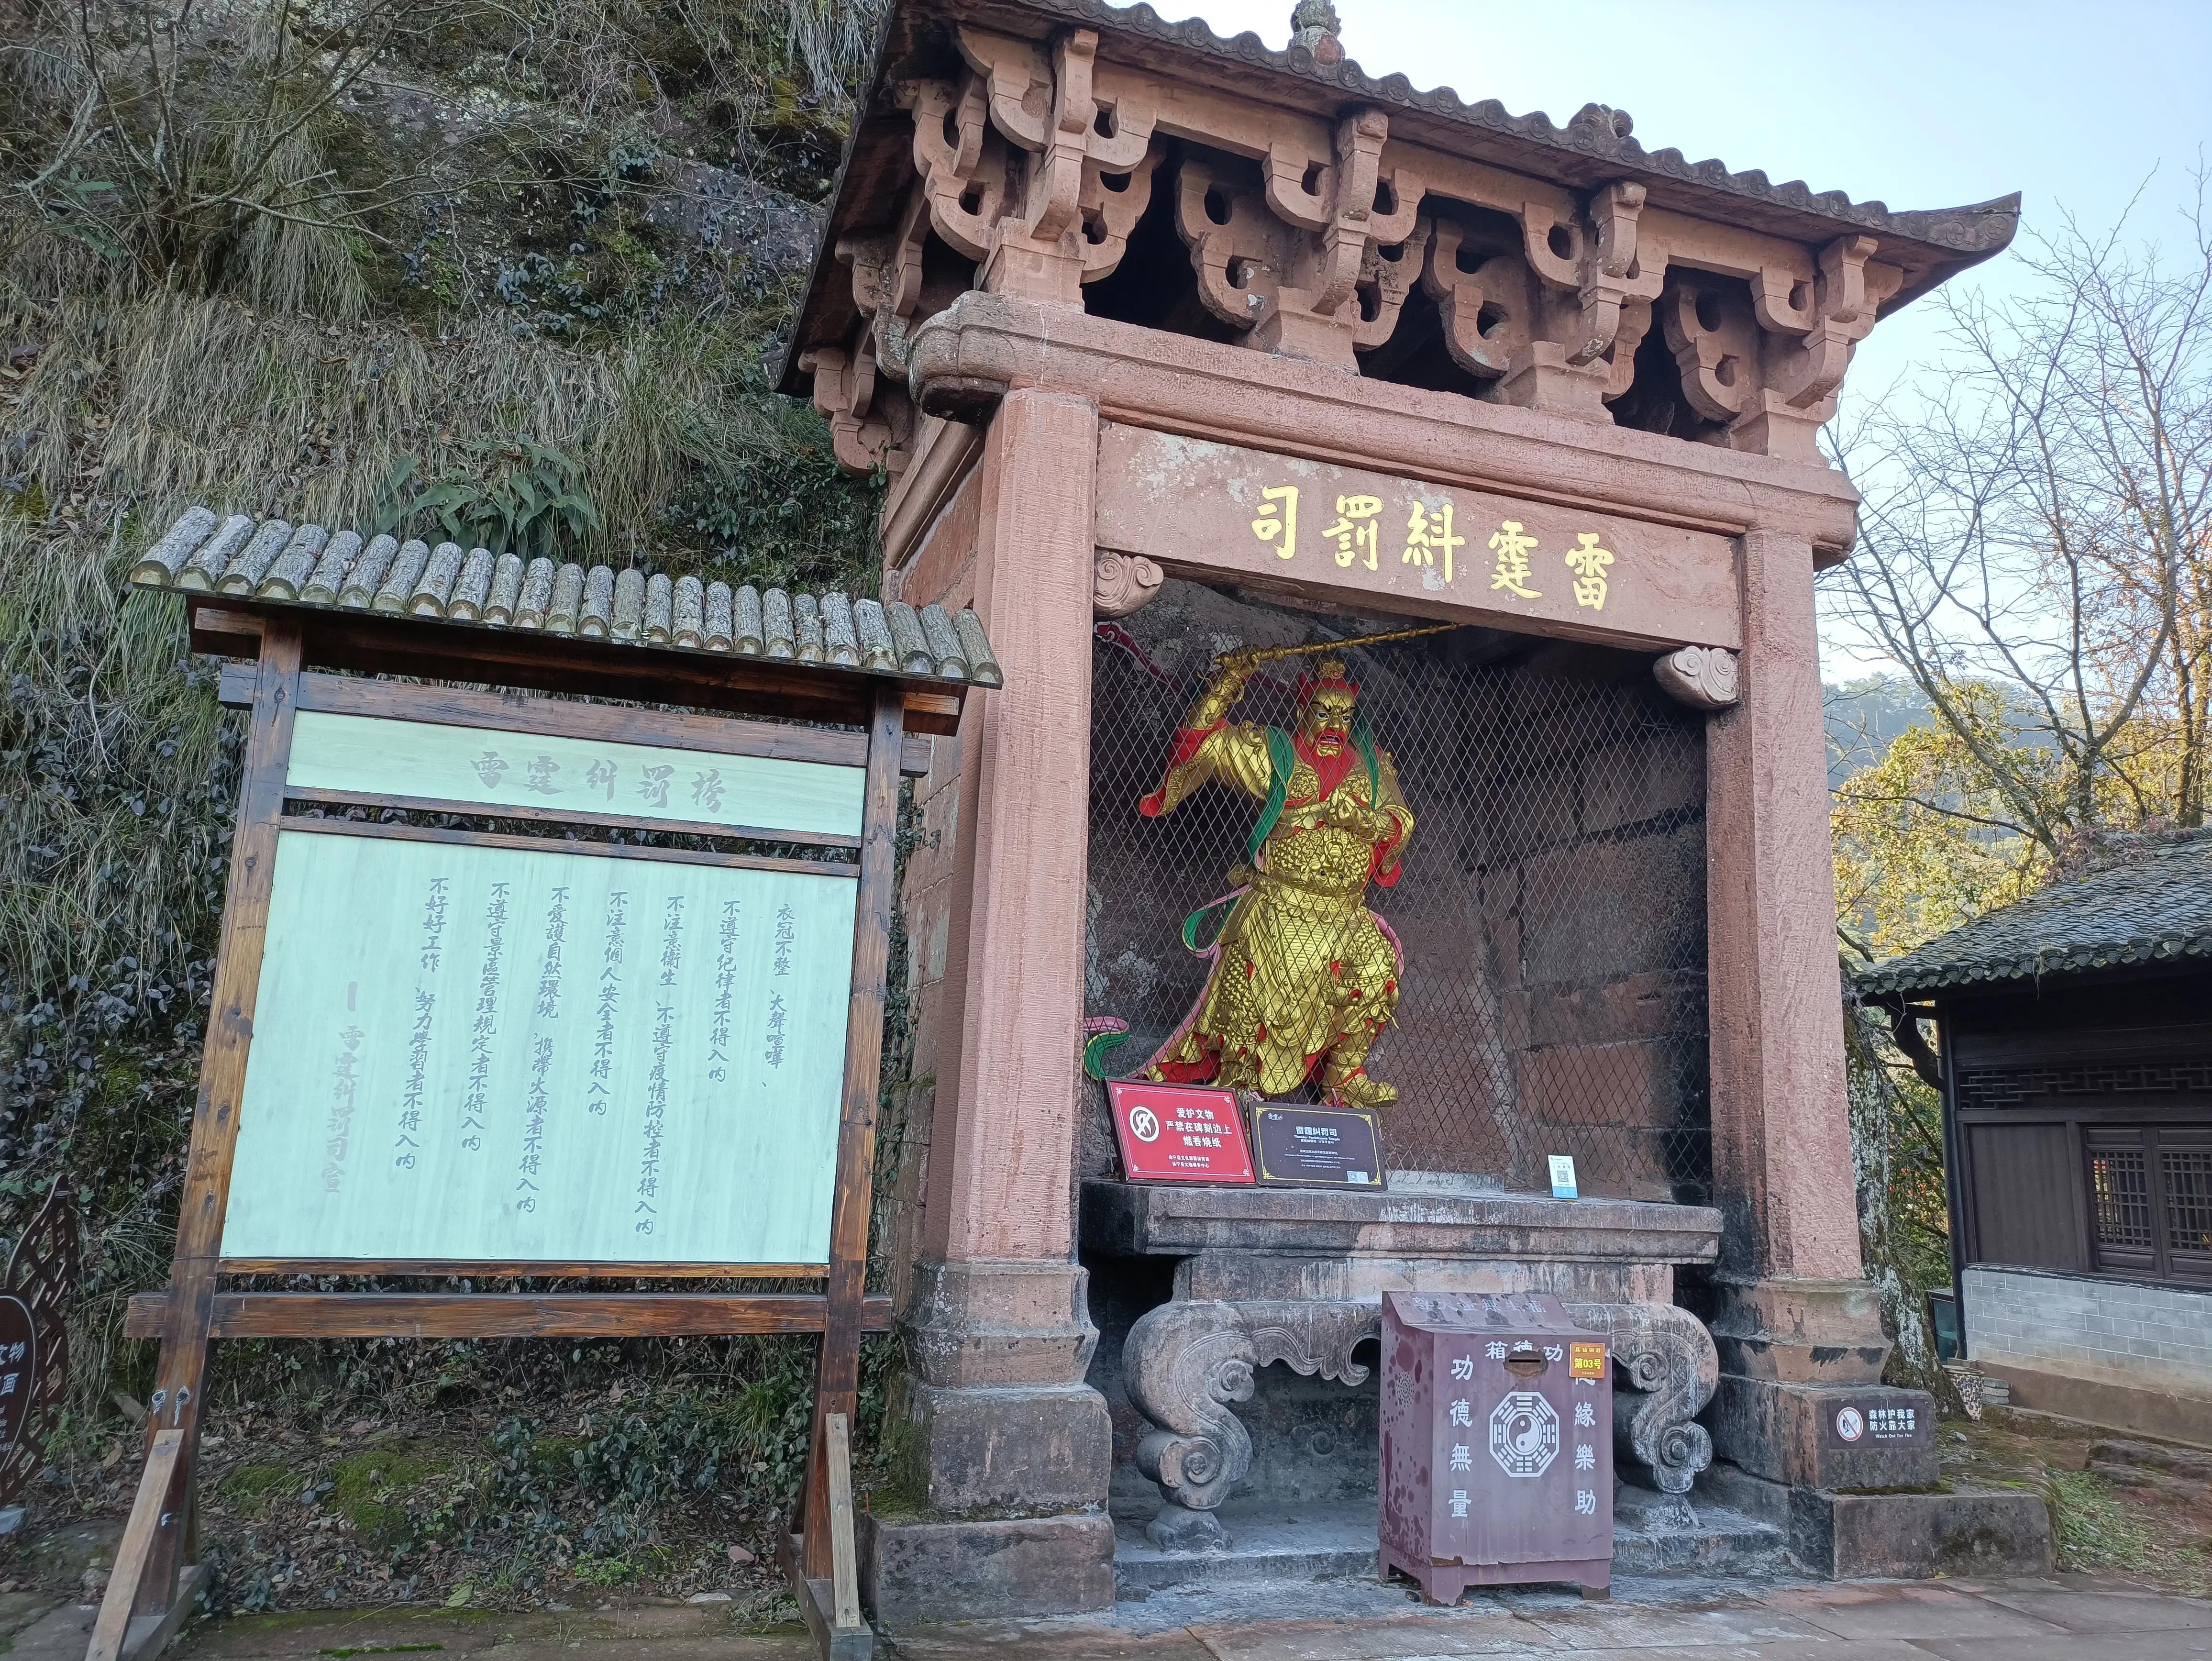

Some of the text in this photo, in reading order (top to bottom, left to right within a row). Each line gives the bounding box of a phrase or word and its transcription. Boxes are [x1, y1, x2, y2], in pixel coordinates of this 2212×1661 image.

[1176, 1107, 1214, 1120] 爱护文物
[1165, 1120, 1233, 1134] 严禁在碑刻边上
[1183, 1135, 1222, 1148] 燃香烧纸
[1574, 1358, 1601, 1369] 第03号
[1869, 1408, 1914, 1420] 森林护我家
[1869, 1420, 1915, 1431] 防火靠大家
[1448, 1354, 1474, 1518] 功德無量
